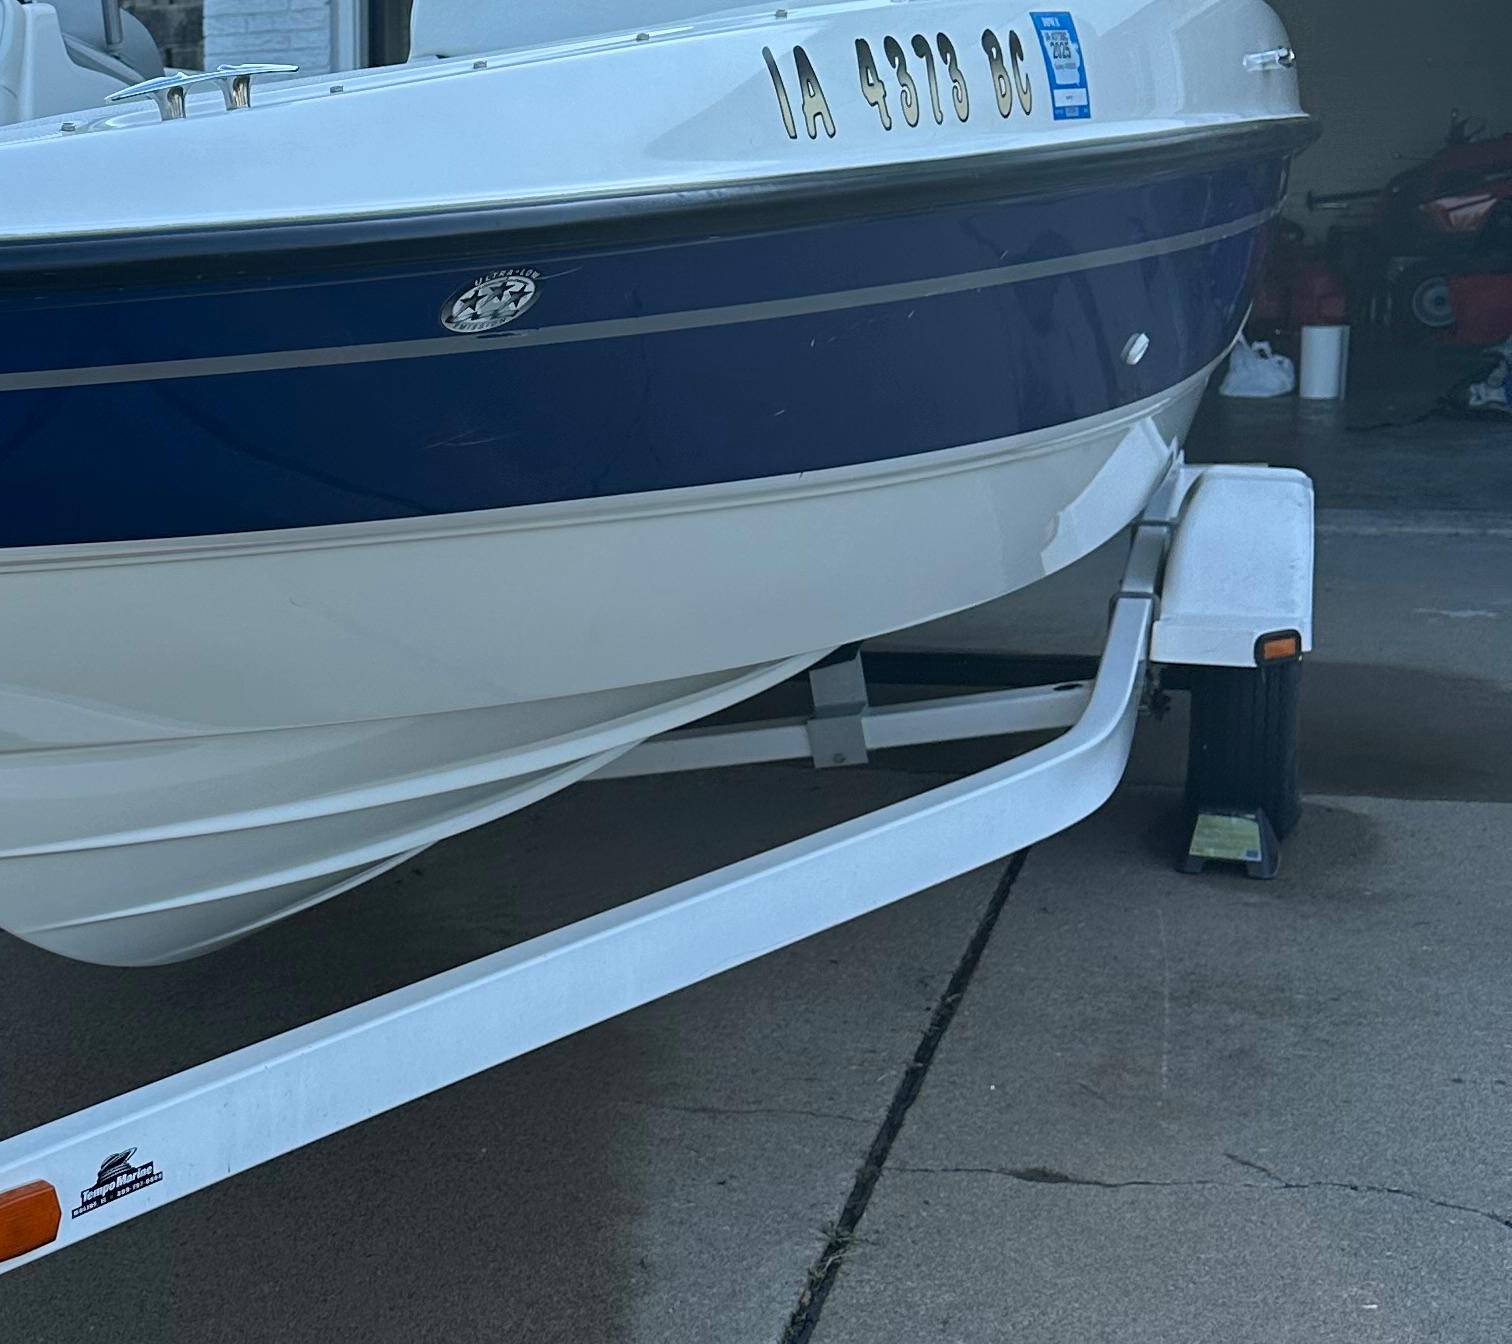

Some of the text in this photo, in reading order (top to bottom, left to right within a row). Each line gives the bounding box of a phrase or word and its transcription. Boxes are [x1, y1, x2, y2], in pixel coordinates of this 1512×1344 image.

[1050, 42, 1071, 59] 2025
[762, 28, 1033, 140] IA 4373 BC
[82, 1165, 153, 1202] Tempo Marine
